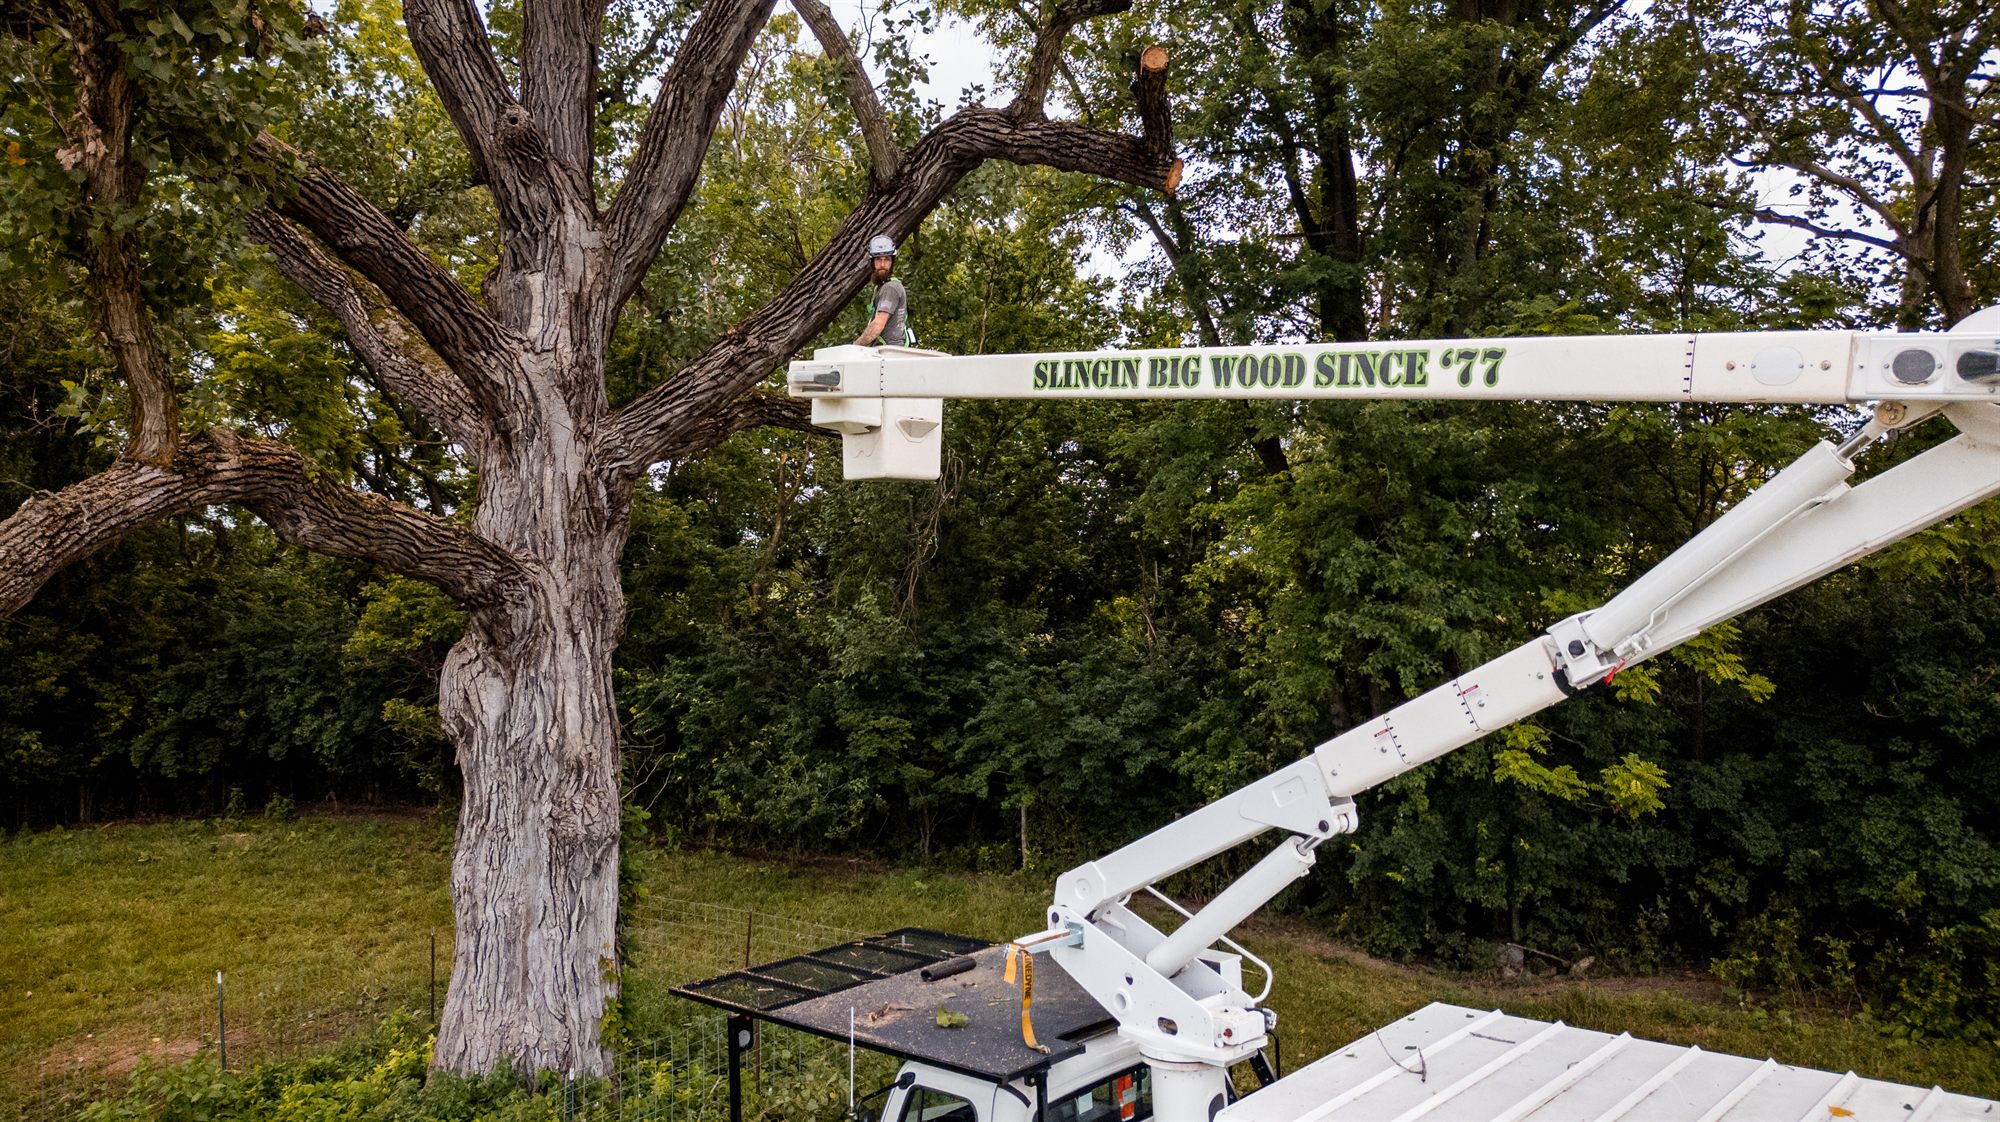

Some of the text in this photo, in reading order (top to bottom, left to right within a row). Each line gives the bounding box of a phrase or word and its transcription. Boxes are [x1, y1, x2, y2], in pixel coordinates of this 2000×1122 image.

[1033, 357, 1142, 389] SLINGIN
[1148, 355, 1201, 388] BIG
[1210, 353, 1307, 388] WOOD
[1313, 350, 1430, 388] SINCE
